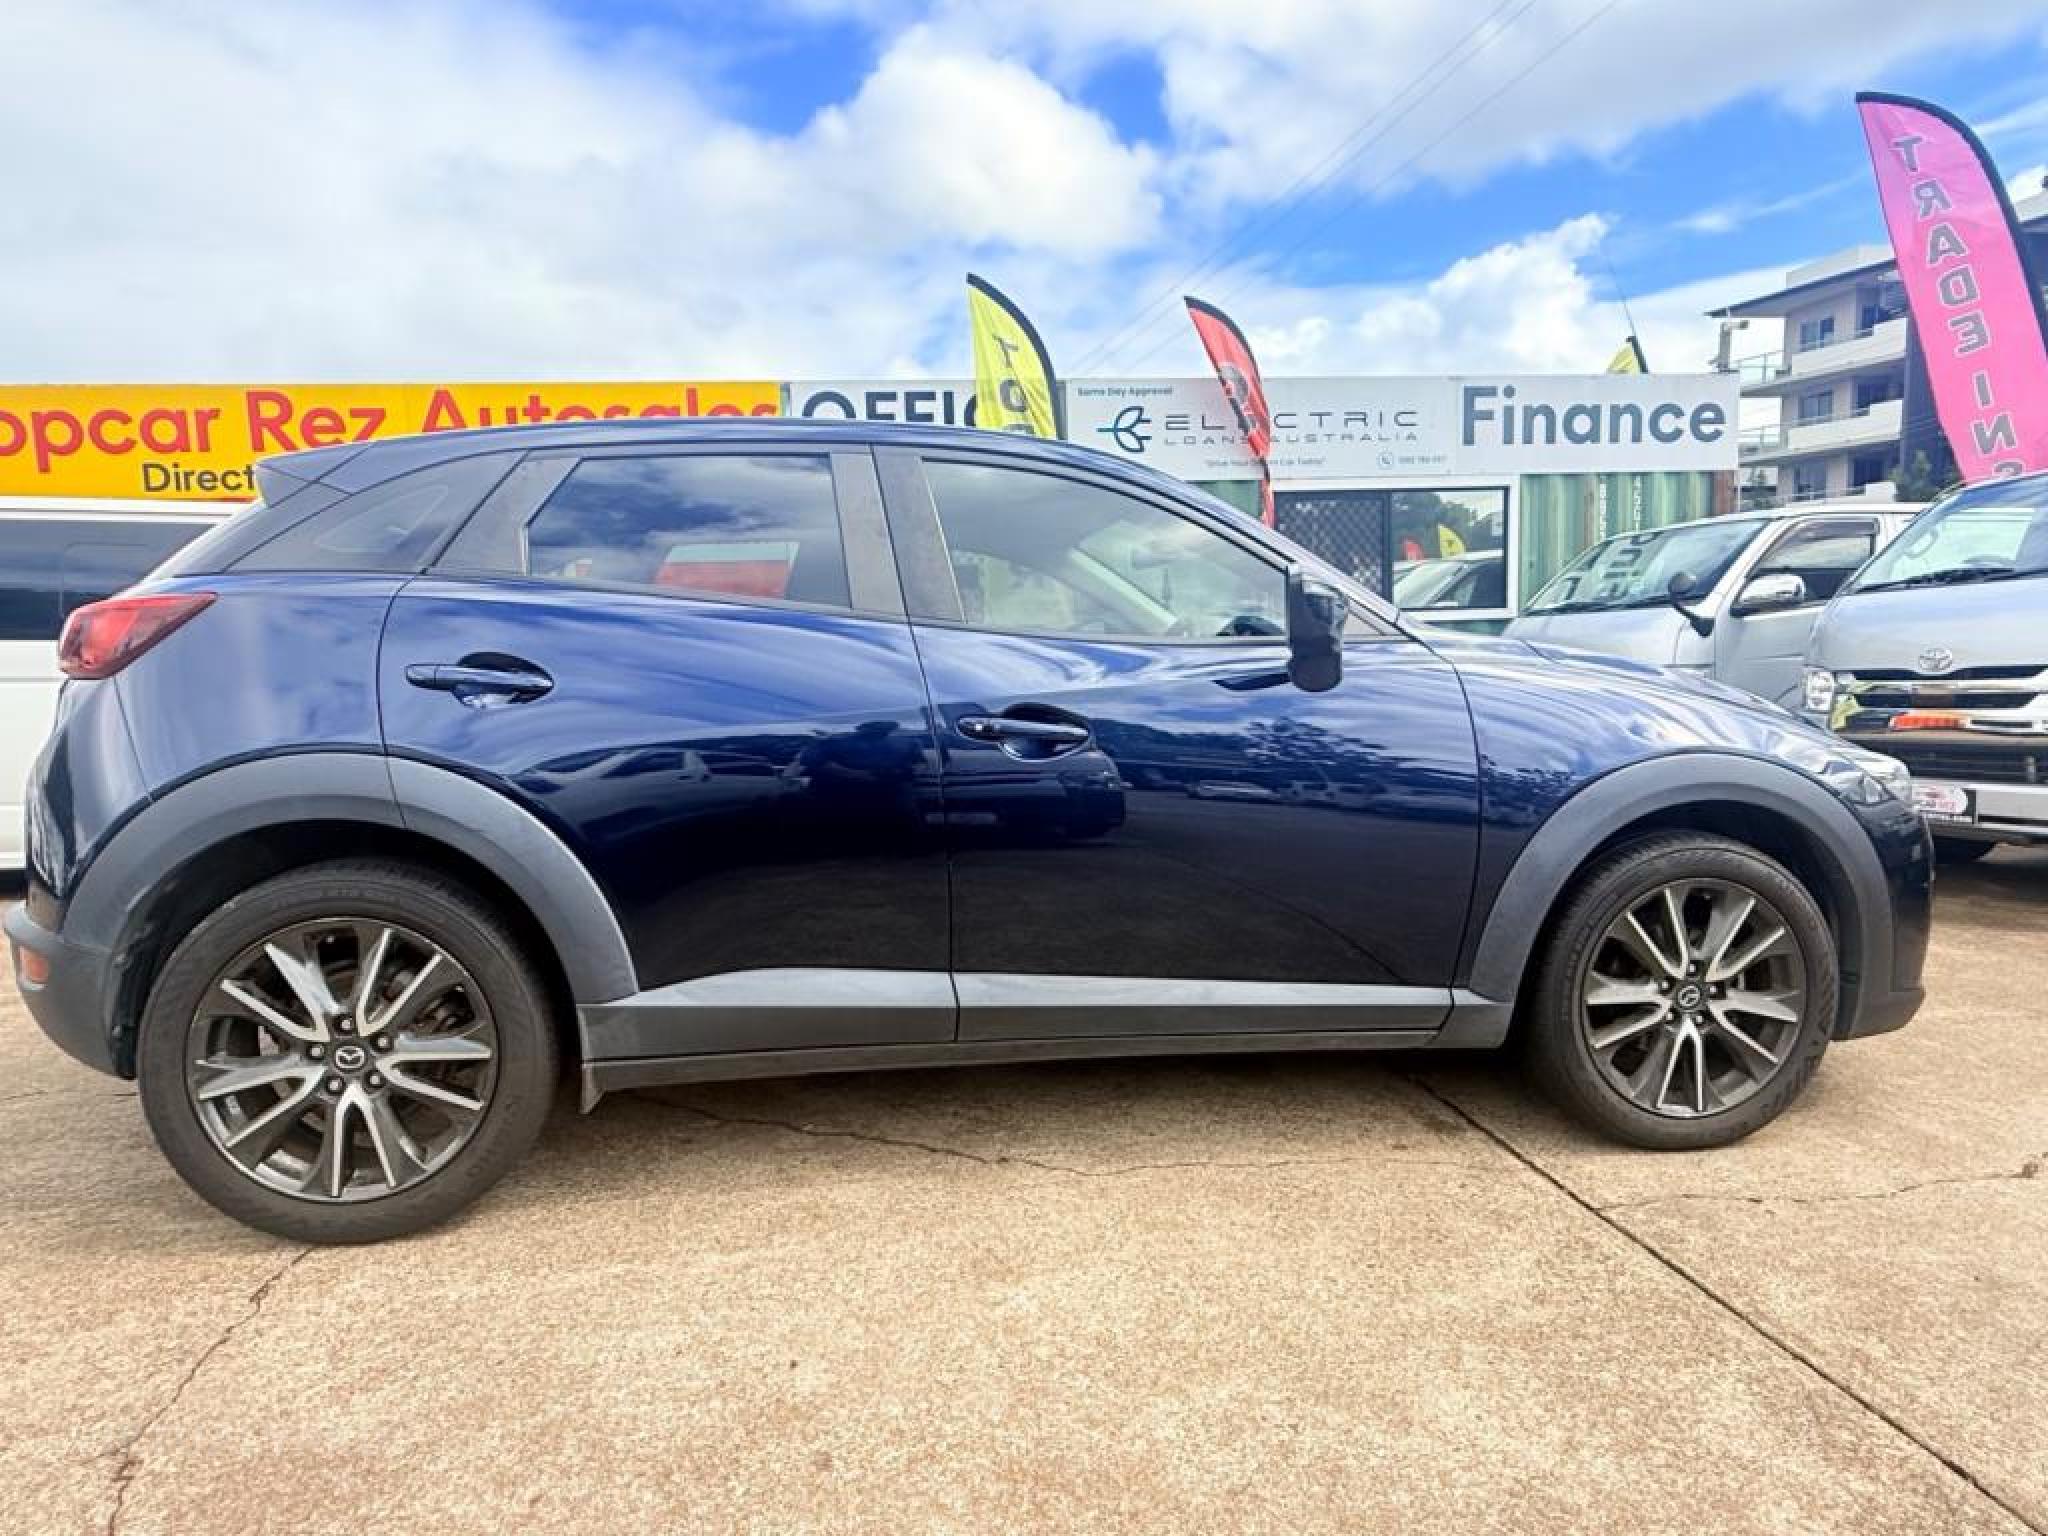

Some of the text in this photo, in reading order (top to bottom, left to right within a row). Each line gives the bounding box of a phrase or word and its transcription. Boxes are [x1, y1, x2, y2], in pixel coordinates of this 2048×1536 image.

[245, 390, 386, 453] Rez
[1165, 411, 1418, 431] ELCTRIC
[1462, 384, 1727, 445] Finance
[141, 462, 256, 493] Direct
